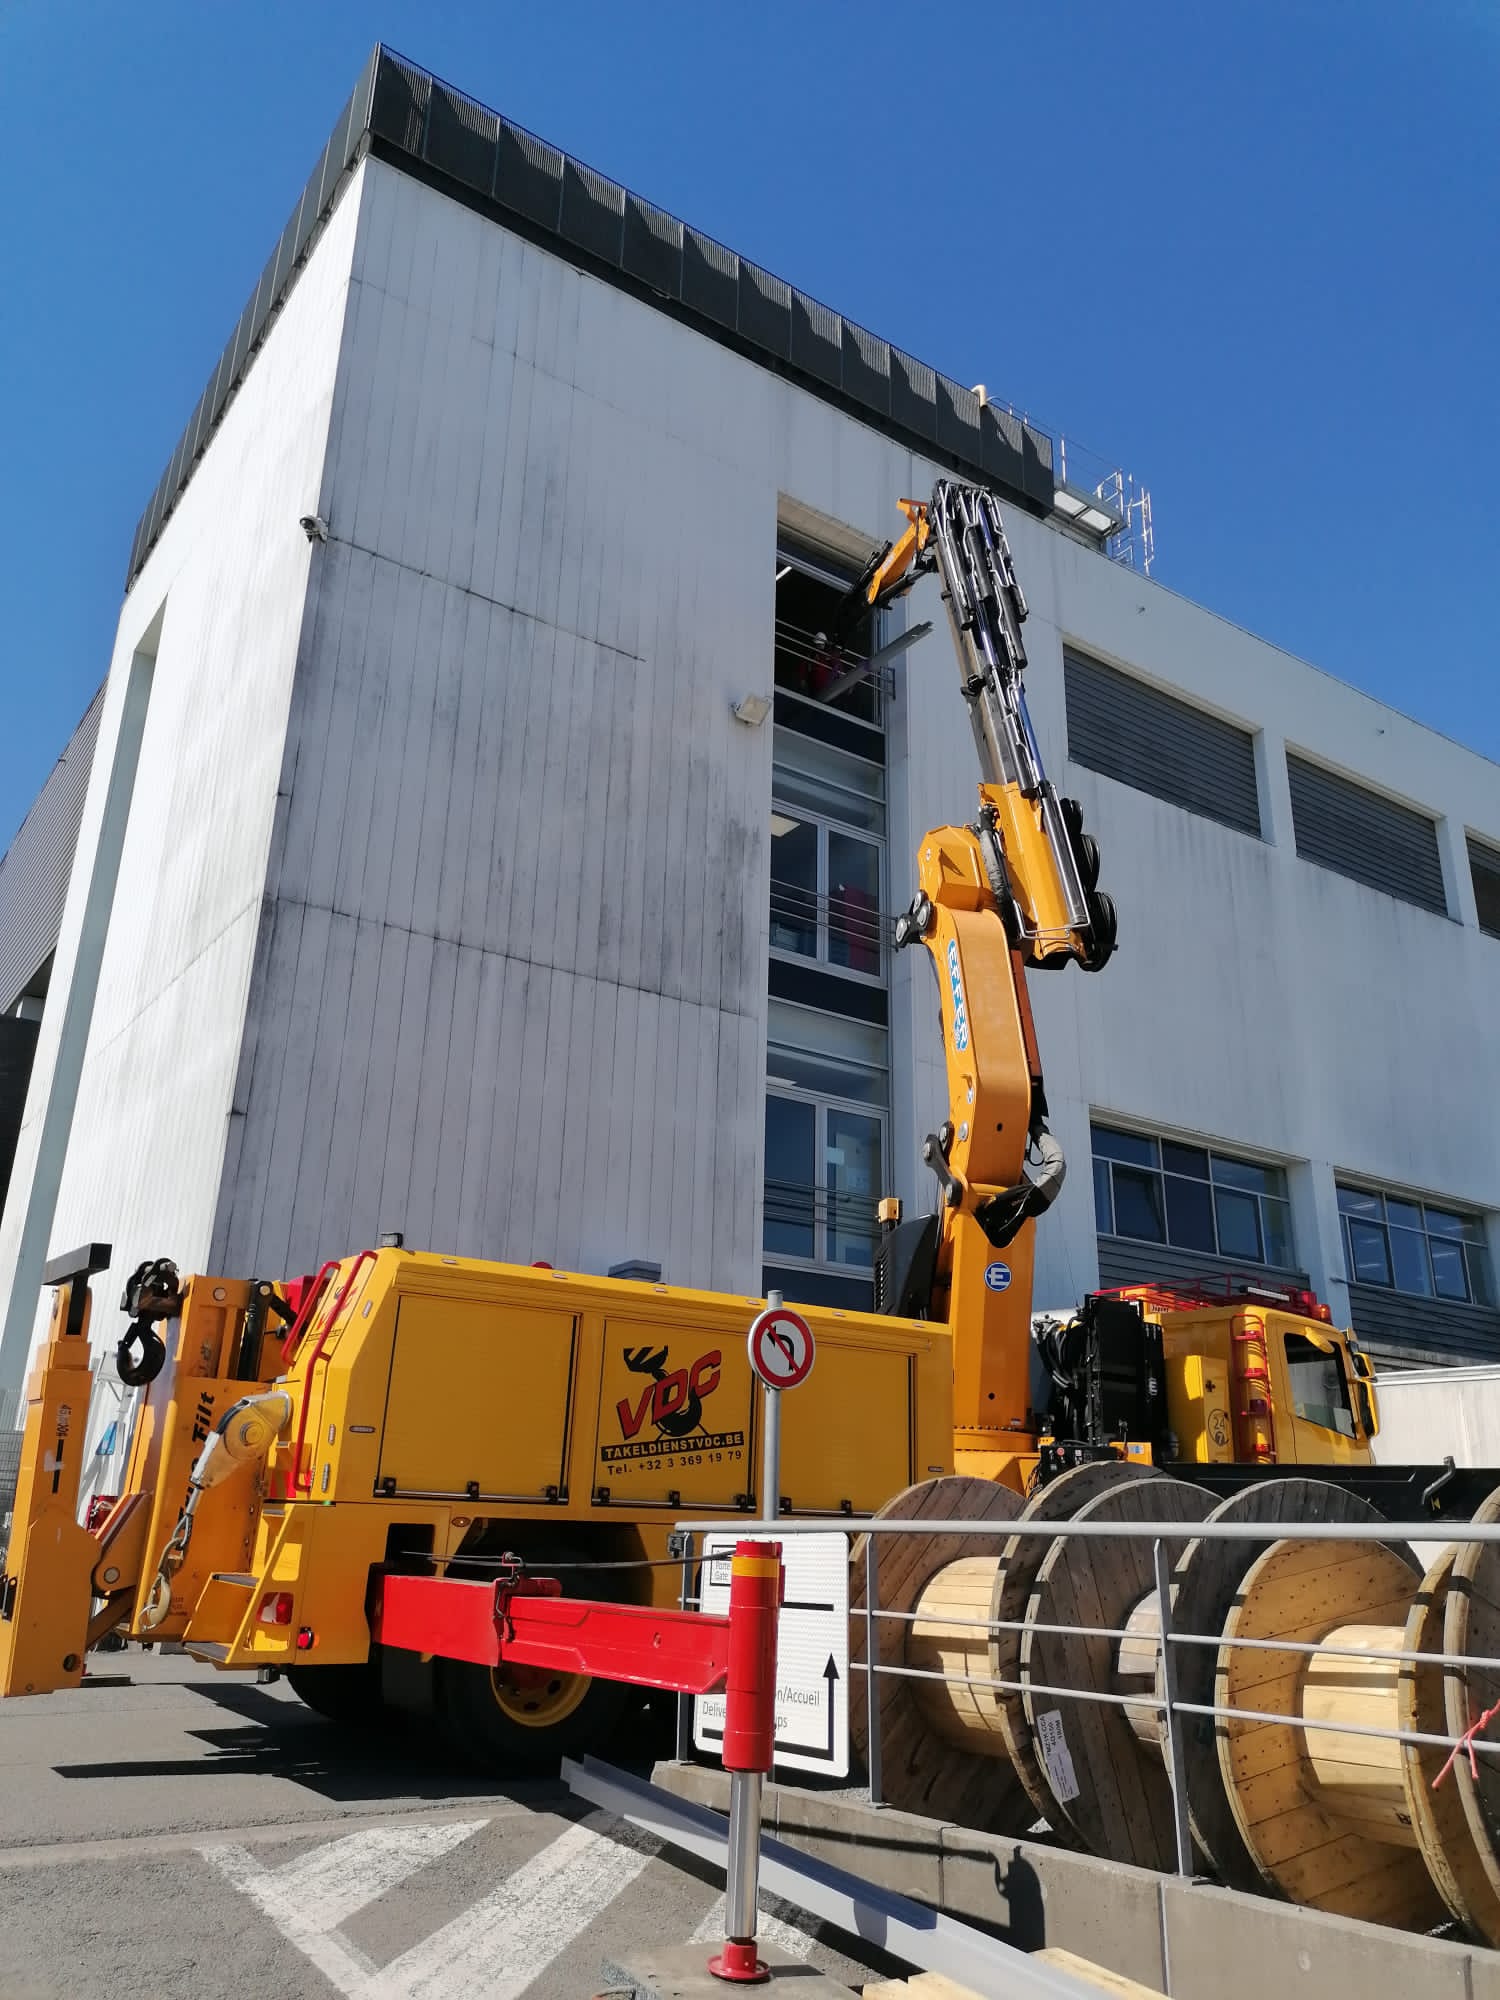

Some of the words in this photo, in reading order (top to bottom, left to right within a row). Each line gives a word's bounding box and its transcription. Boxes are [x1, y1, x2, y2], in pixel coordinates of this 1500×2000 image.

[616, 1350, 722, 1440] VDC
[605, 1433, 742, 1459] TAKELDIENSTVDC.BE
[608, 1465, 632, 1475] Tel.
[639, 1459, 661, 1471] +32
[668, 1458, 674, 1468] 3
[680, 1455, 702, 1465] 369
[709, 1452, 722, 1463] 19
[728, 1450, 742, 1460] 79
[776, 1687, 820, 1705] n/Accueil
[703, 1702, 727, 1717] Delive
